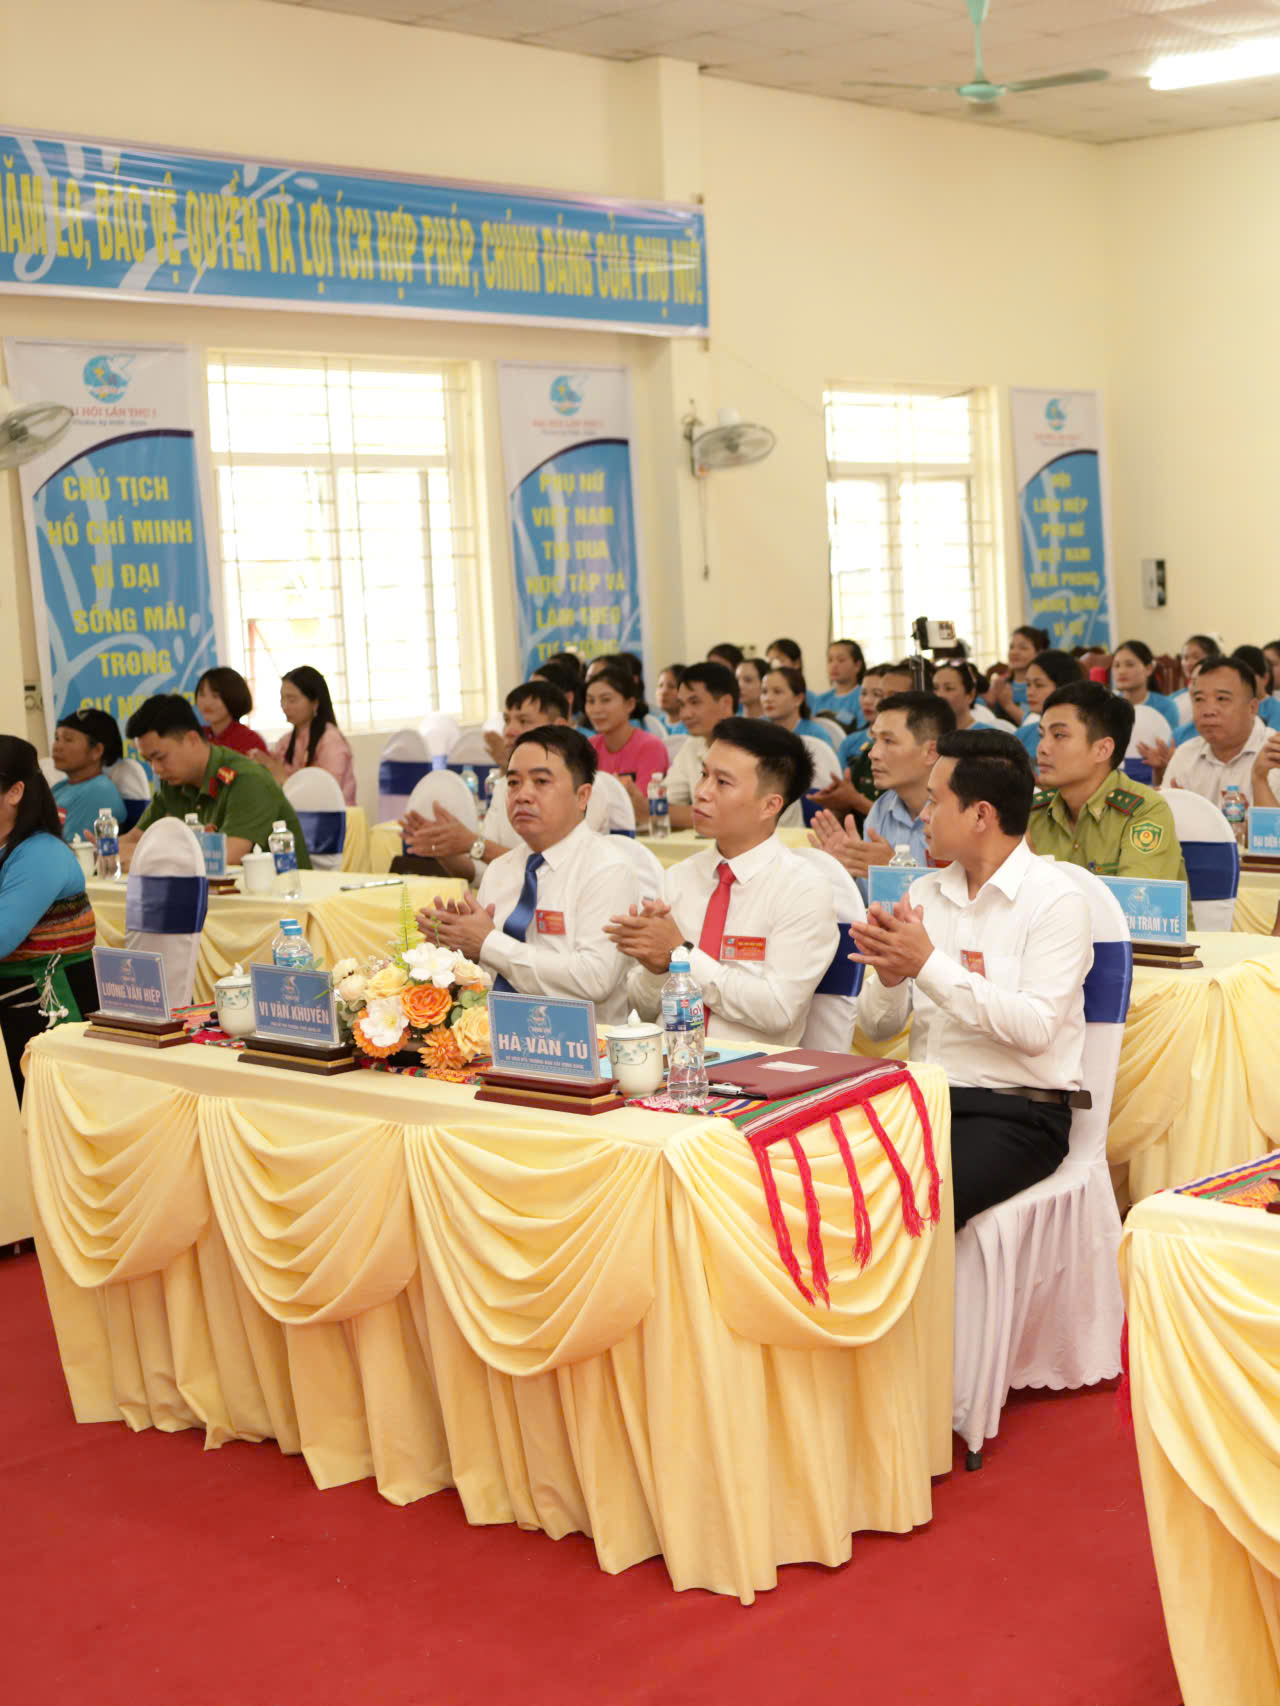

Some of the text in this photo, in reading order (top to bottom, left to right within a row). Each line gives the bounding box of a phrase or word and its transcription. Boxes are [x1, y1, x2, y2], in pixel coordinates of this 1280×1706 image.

[94, 153, 146, 265] BẢO
[148, 171, 182, 284] VỆ
[262, 183, 297, 275] VÀ
[296, 196, 334, 294] LỢI
[335, 189, 375, 281] ÍCH
[375, 203, 418, 300] HỢP
[481, 207, 541, 294] CHÍNH
[541, 212, 594, 297] ĐÁNG
[595, 210, 634, 301] CỦA
[634, 235, 670, 318] PHỤ
[63, 467, 169, 507] CHỦ TỊCH
[86, 514, 126, 545] CHÍ
[132, 519, 193, 545] MINH
[120, 562, 160, 593] ĐẠI
[73, 600, 186, 635] SỐNG MÃI
[97, 648, 172, 678] TRONG
[258, 1000, 269, 1017] VI
[270, 1001, 290, 1019] VĂN
[498, 1031, 588, 1060] HÀ VĂN TÚ
